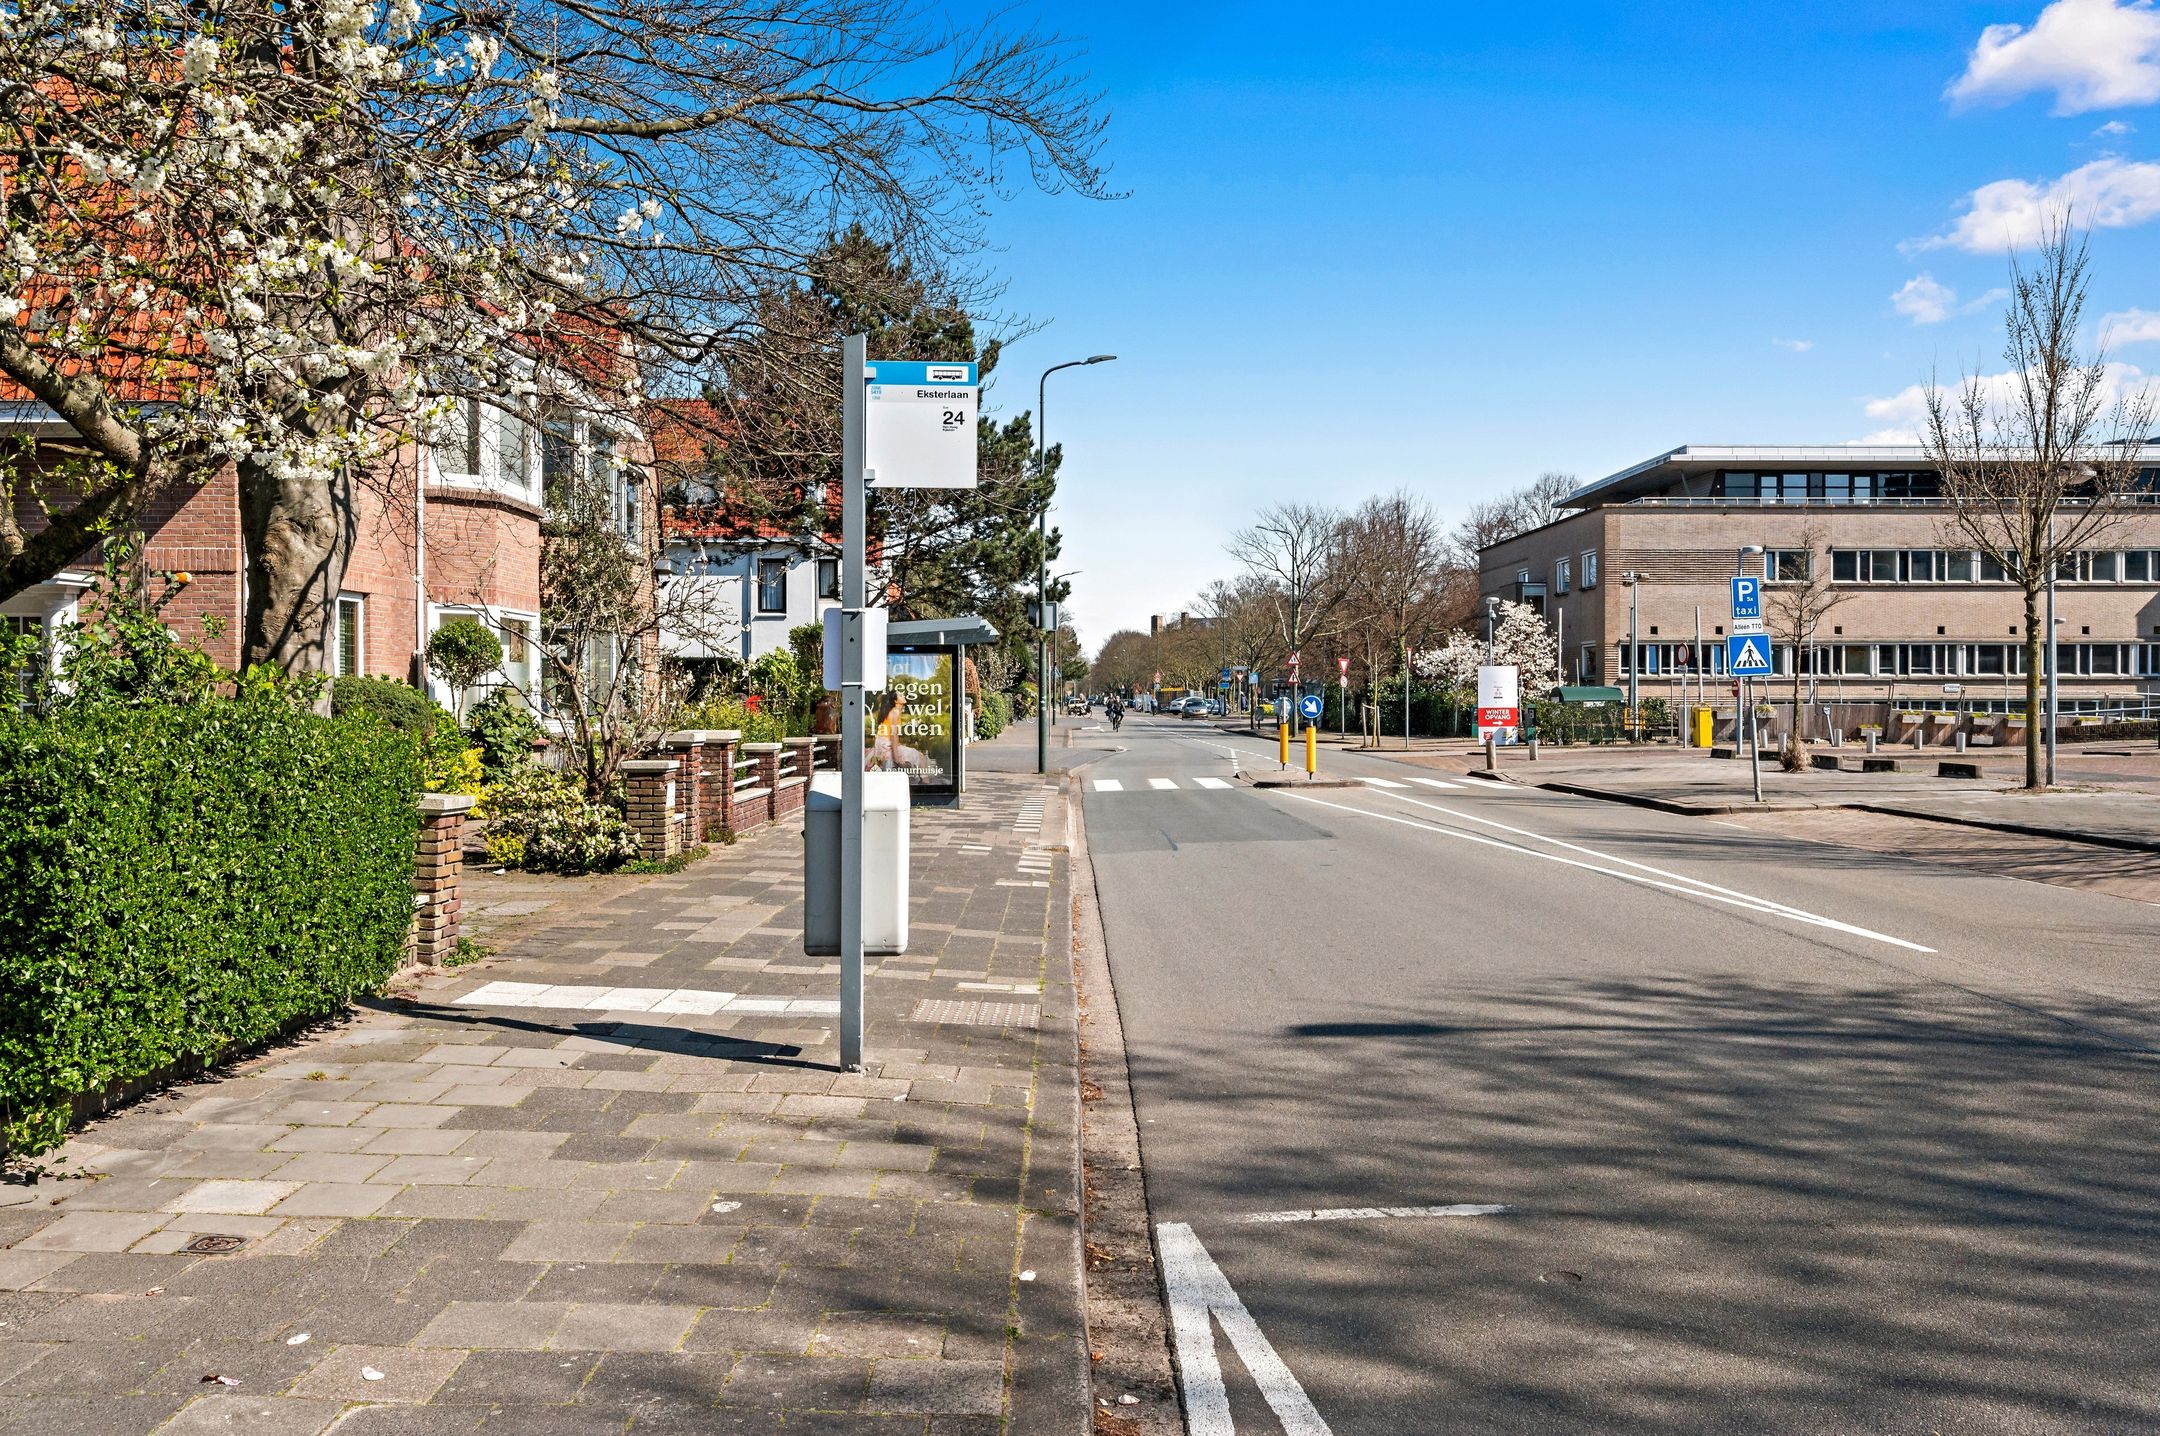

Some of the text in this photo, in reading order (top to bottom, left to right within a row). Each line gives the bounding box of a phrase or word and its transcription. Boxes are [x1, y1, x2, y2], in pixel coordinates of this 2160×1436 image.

[917, 390, 969, 399] Eksterlaan
[943, 411, 965, 425] 24
[1738, 581, 1753, 602] P
[1736, 606, 1756, 615] taxi
[907, 699, 942, 716] wel
[870, 718, 942, 736] landen
